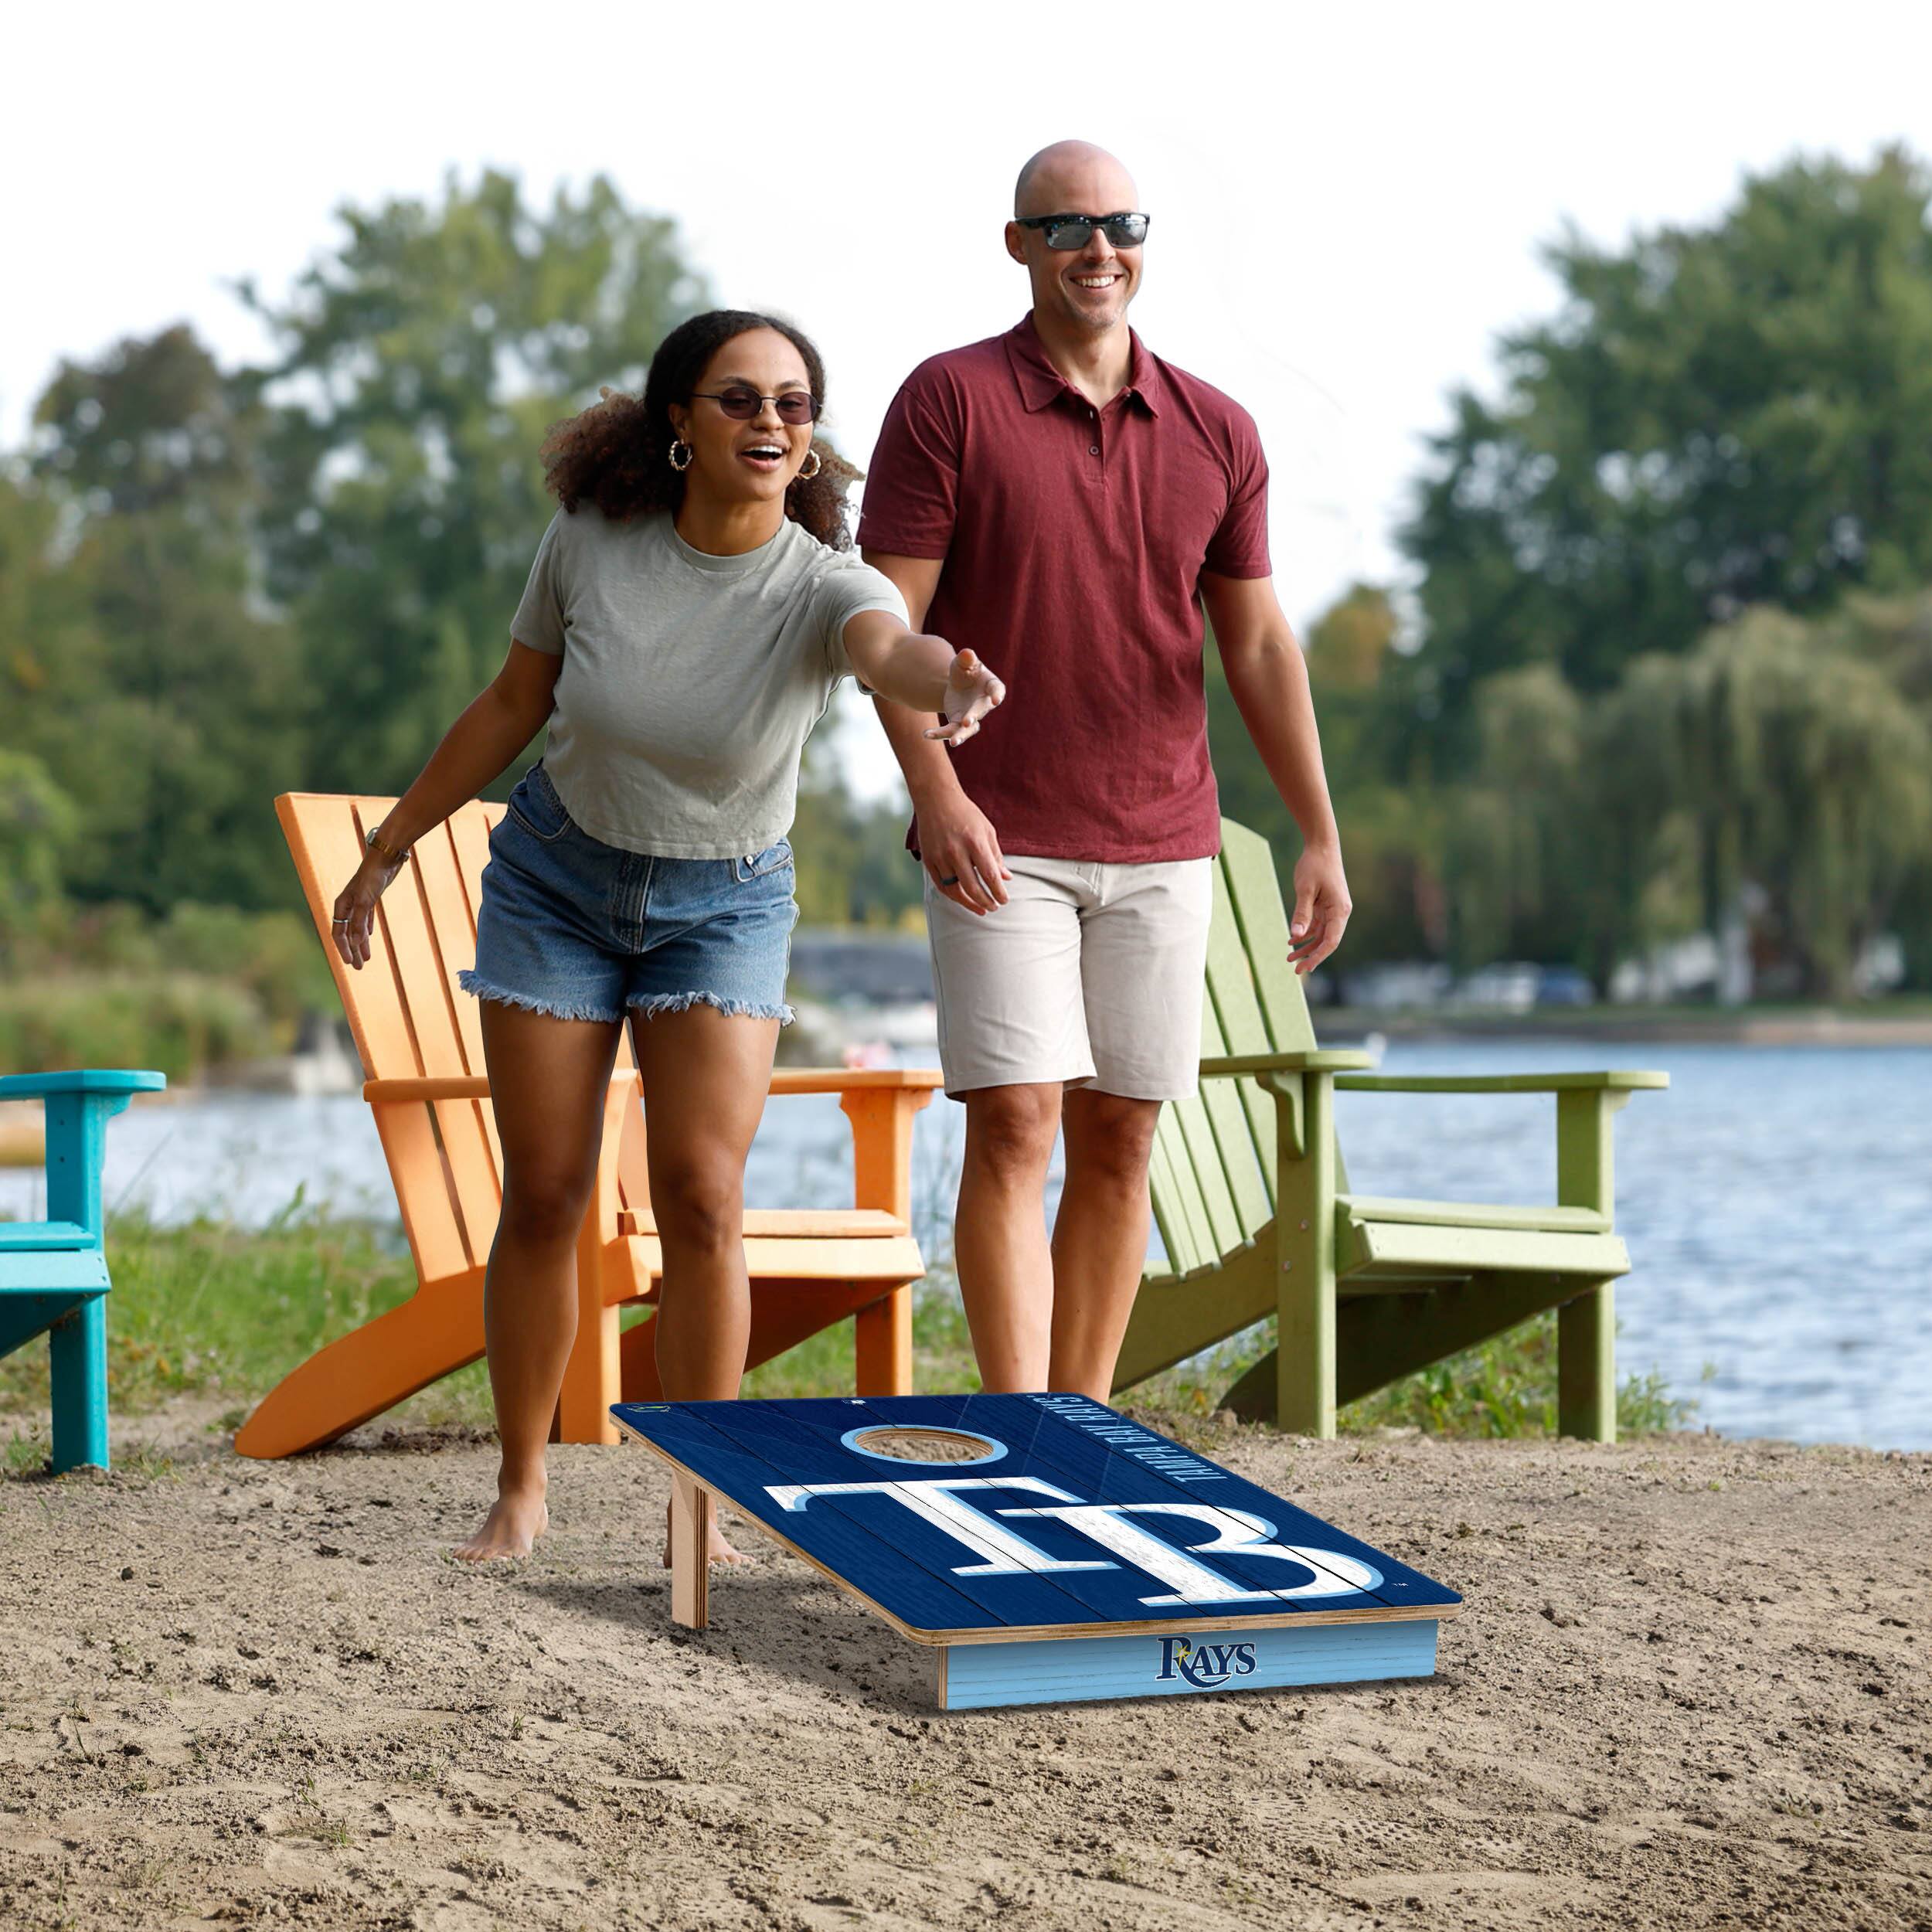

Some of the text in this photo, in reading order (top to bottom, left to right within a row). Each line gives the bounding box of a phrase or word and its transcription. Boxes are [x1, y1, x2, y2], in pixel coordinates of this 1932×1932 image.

[1032, 1396, 1229, 1483] TAMPA BAY RAYS
[1155, 1635, 1258, 1689] RAYS
